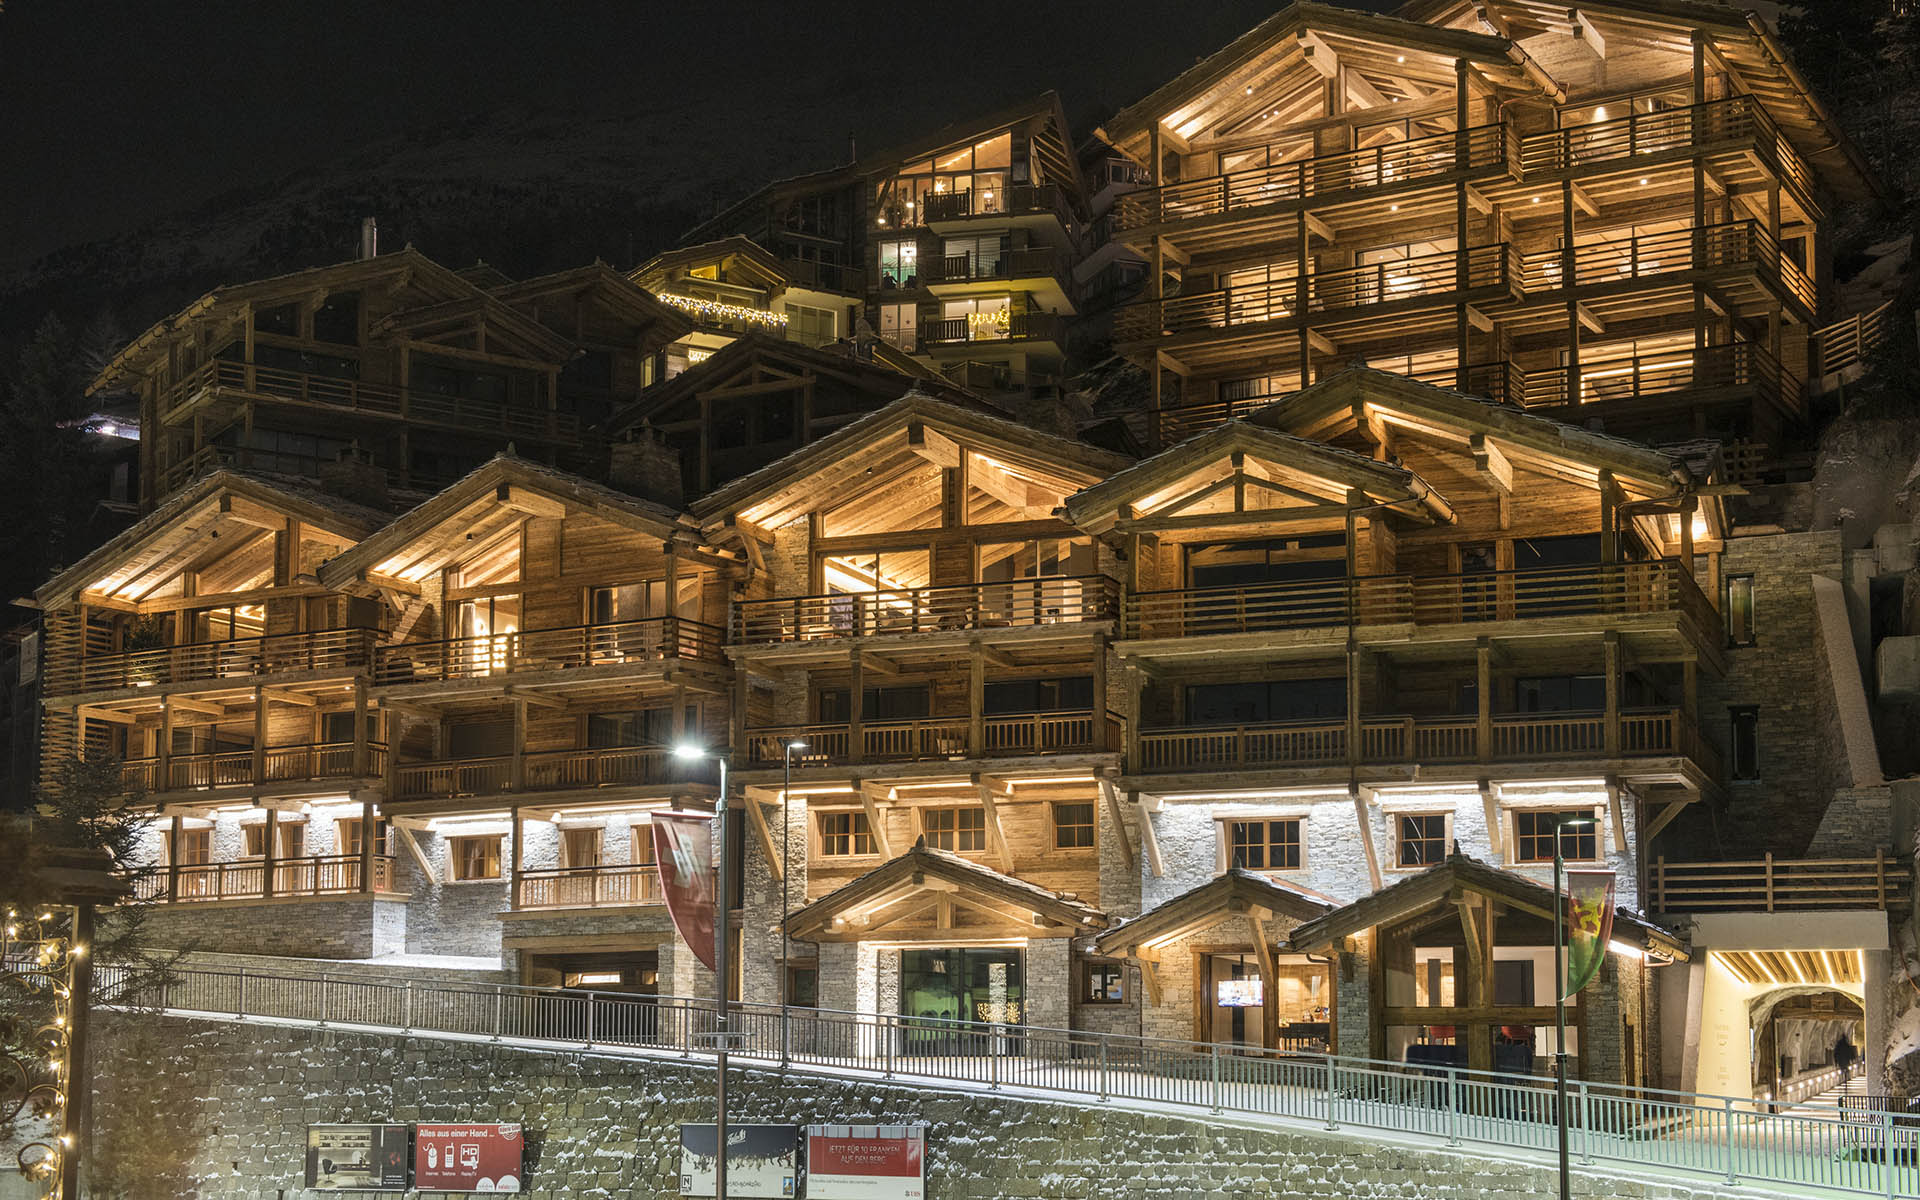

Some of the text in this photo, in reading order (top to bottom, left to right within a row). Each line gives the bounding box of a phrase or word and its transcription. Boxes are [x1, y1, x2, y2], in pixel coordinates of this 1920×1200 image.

[419, 1129, 436, 1137] Alles
[450, 1129, 468, 1137] einer
[469, 1128, 488, 1137] Hand
[829, 1144, 900, 1153] JETZT FÜR 10 FRANKEN
[841, 1156, 886, 1164] AUF DEN BERG
[683, 1177, 690, 1186] N
